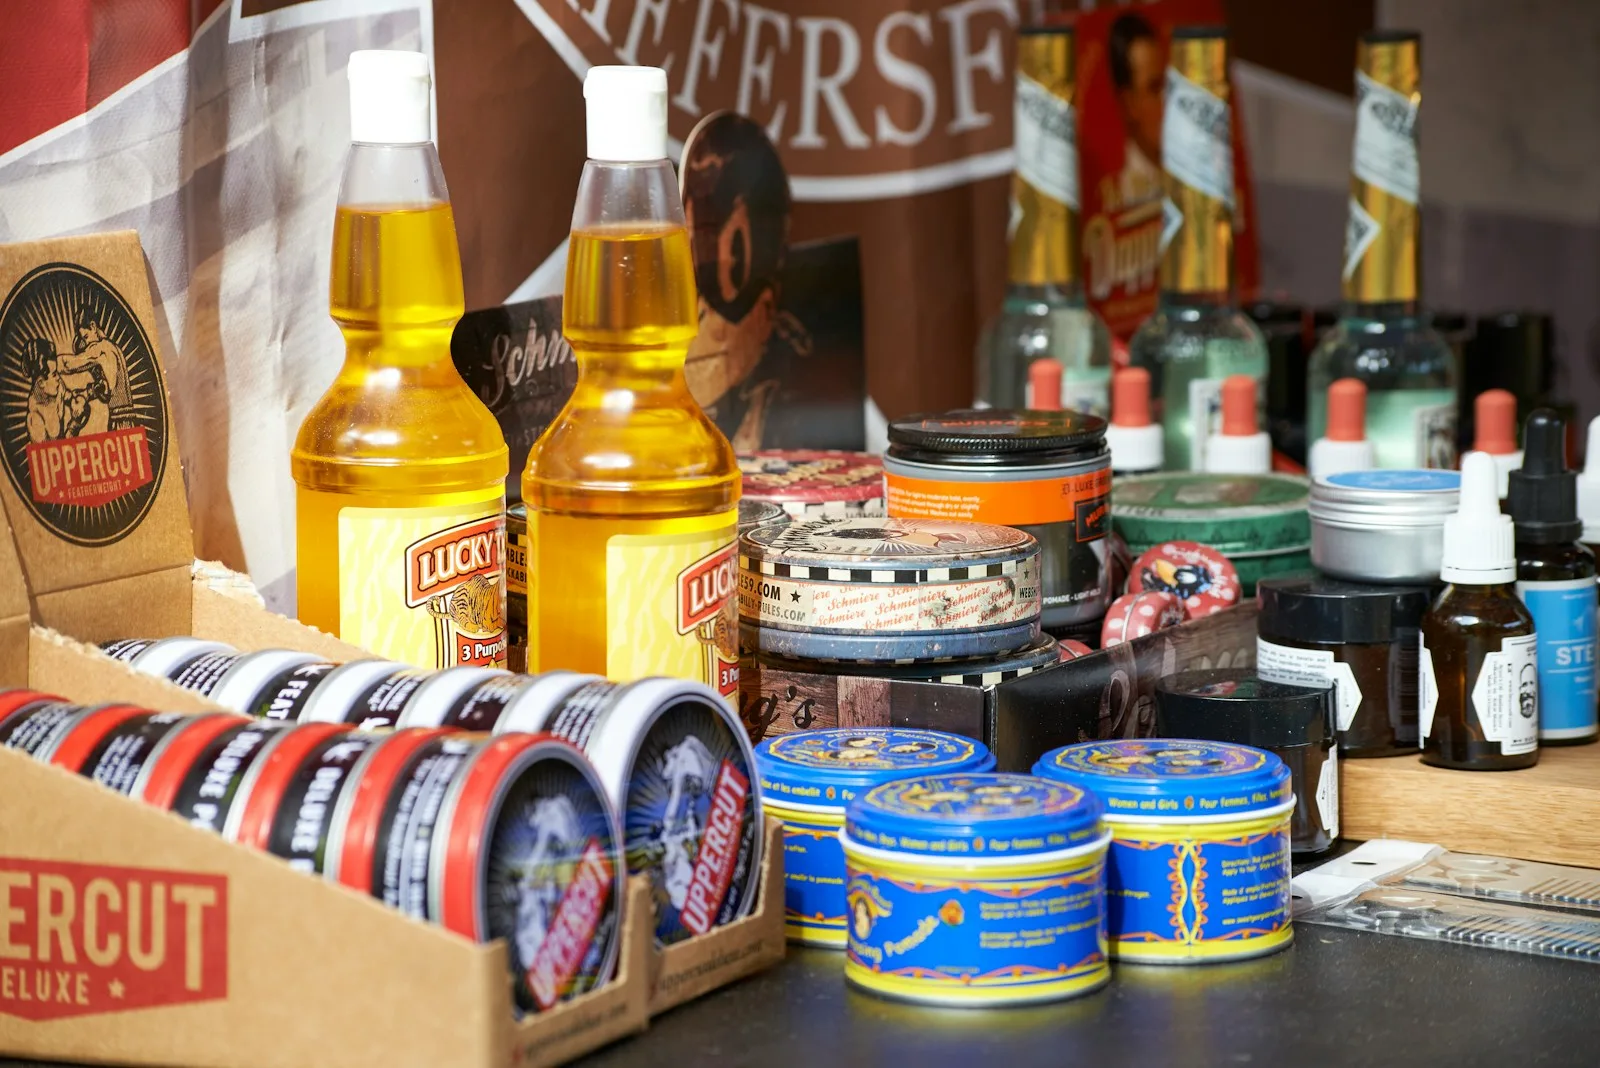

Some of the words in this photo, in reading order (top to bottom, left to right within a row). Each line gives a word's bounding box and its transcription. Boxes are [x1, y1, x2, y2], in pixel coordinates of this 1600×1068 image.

[31, 432, 146, 497] UPPERCUT
[67, 479, 122, 499] FEATHERWEIGHT
[418, 529, 494, 591] LUCKY
[828, 591, 880, 612] Schmiere
[1043, 593, 1070, 605] POMADE
[816, 609, 866, 627] Schmiere
[864, 611, 914, 630] Schmiere
[461, 645, 471, 661] 3
[721, 670, 728, 686] 3
[1108, 797, 1138, 809] Women
[1140, 799, 1157, 809] and
[1157, 798, 1179, 810] Girls
[1199, 798, 1218, 809] Pour
[682, 768, 746, 935] UPPERCUT
[0, 870, 217, 991] ERCUT
[1, 966, 90, 1005] ELUXE
